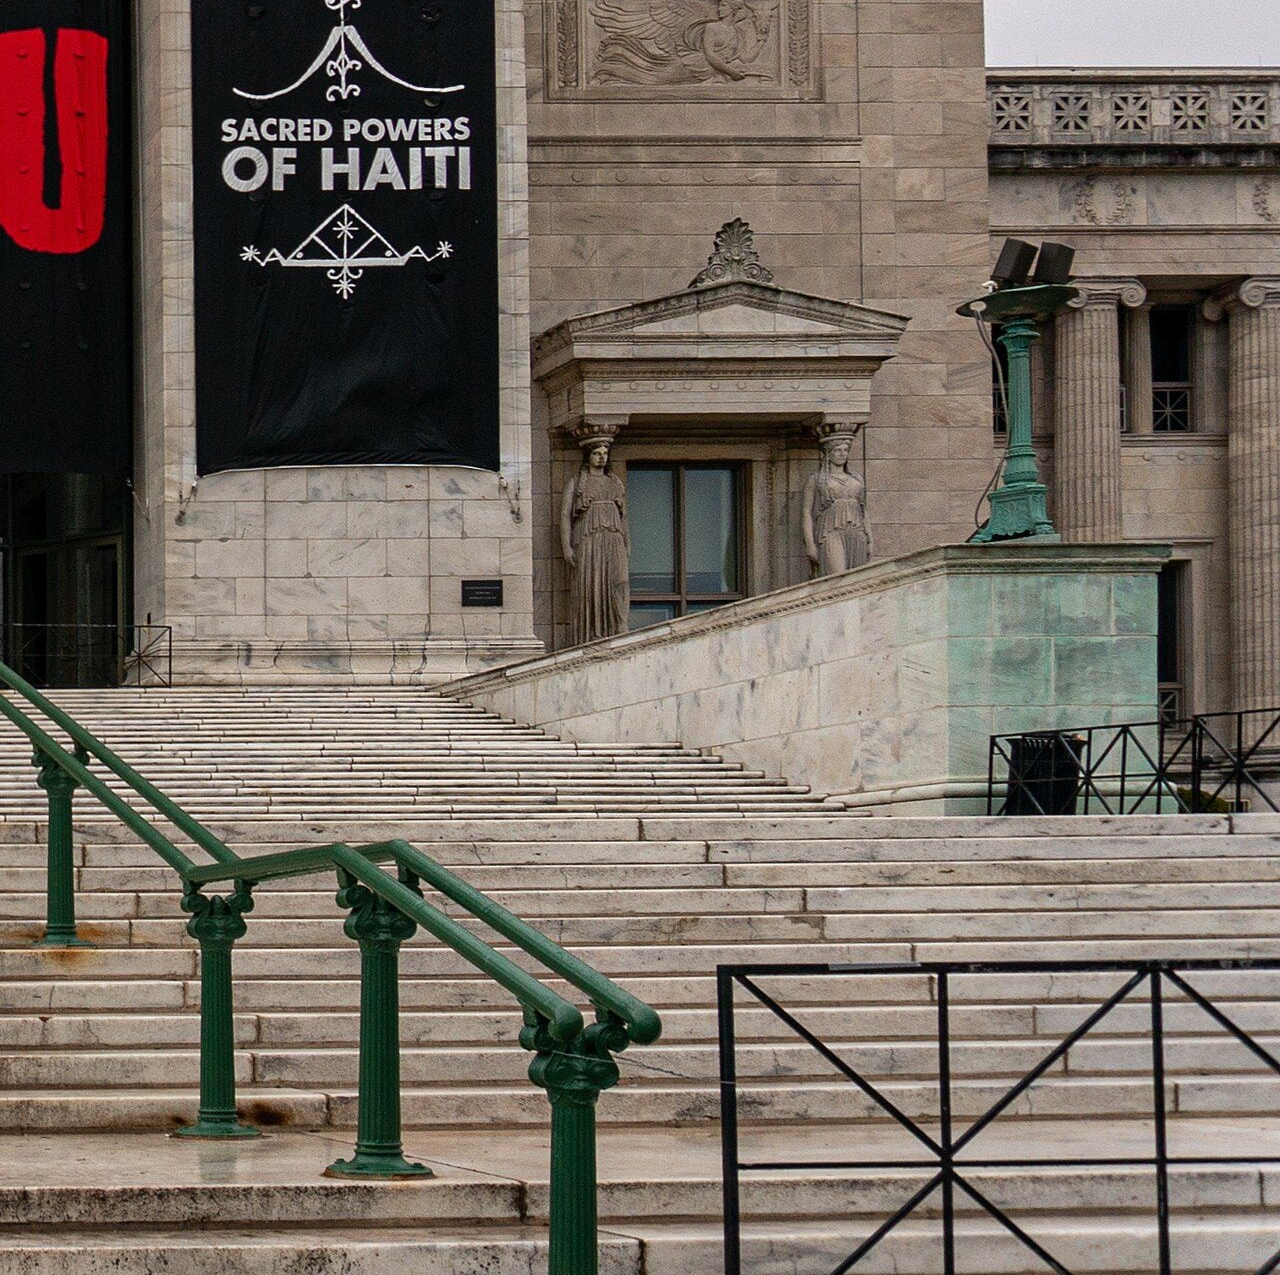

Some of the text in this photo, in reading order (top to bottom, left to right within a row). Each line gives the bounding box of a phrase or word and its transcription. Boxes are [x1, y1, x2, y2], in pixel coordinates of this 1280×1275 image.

[220, 116, 471, 143] SACRED POWERS
[221, 145, 471, 193] OF HAITI
